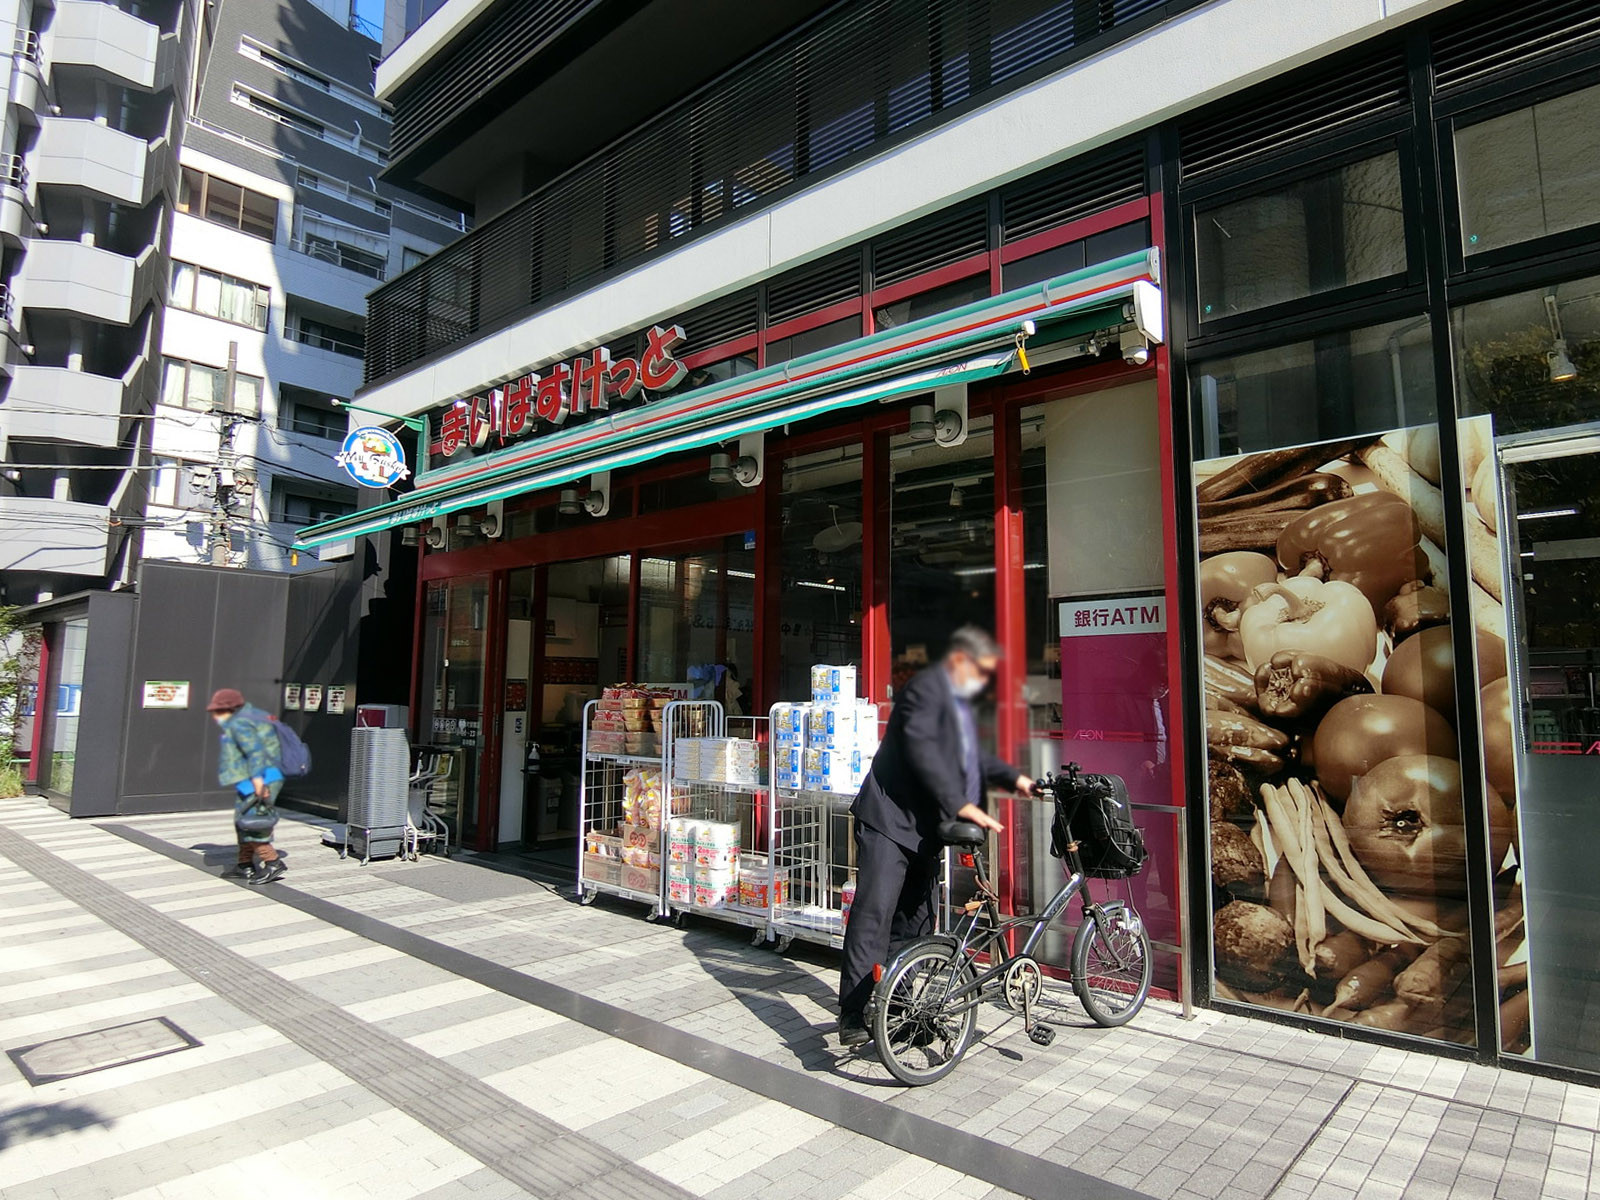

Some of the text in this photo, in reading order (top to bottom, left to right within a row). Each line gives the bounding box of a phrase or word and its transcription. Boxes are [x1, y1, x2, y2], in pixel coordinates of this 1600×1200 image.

[441, 324, 689, 457] まいばすけっと
[1074, 605, 1160, 628] 銀行ATM
